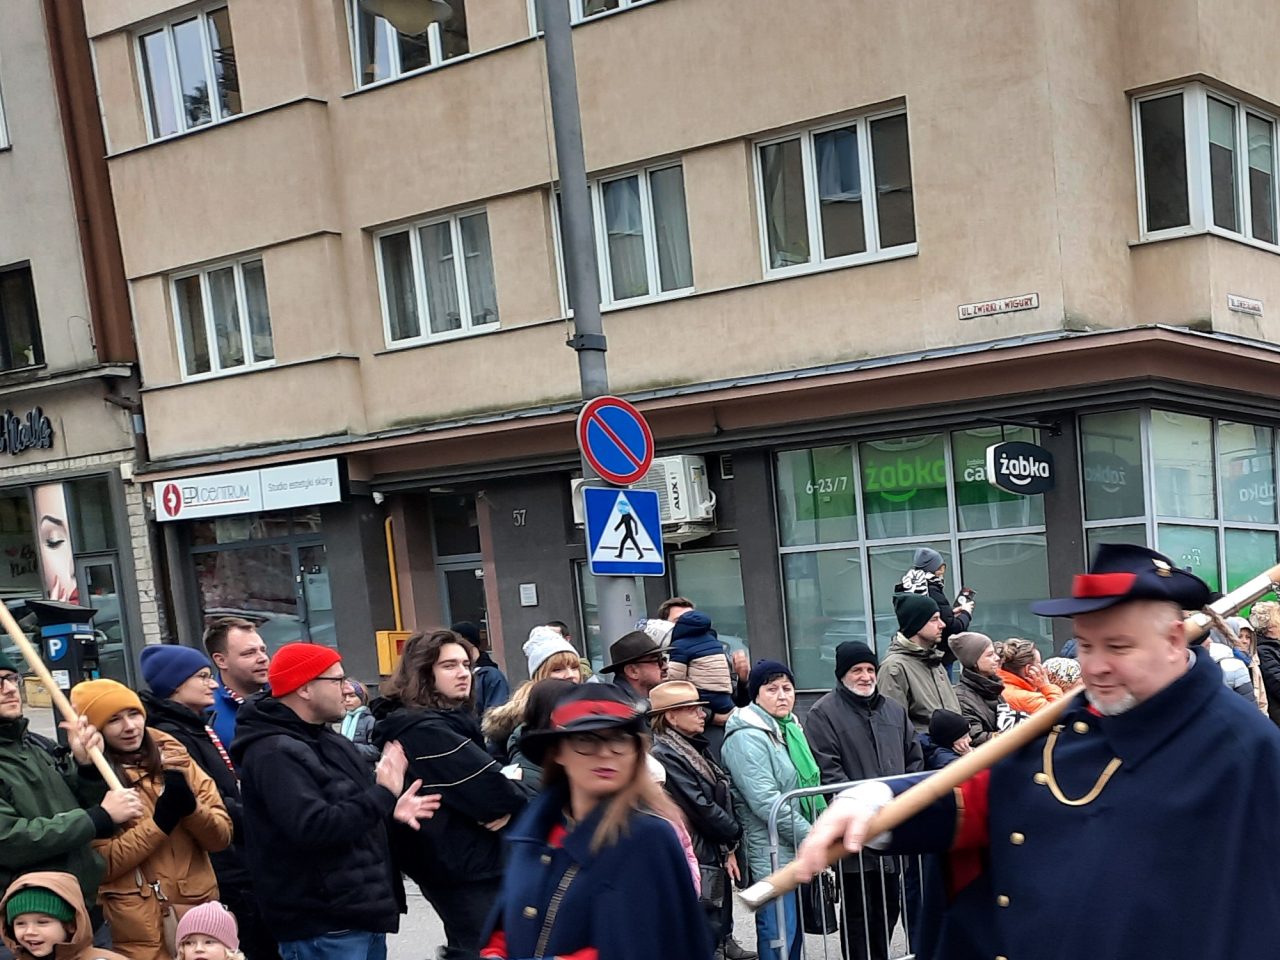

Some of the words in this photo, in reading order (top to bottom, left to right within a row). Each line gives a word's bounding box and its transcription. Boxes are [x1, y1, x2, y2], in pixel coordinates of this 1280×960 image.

[1004, 296, 1033, 309] WIGURY
[1000, 453, 1050, 478] żabka
[806, 476, 848, 494] 6-23/7
[670, 482, 681, 510] AUX
[513, 509, 526, 526] 57
[49, 639, 62, 657] P
